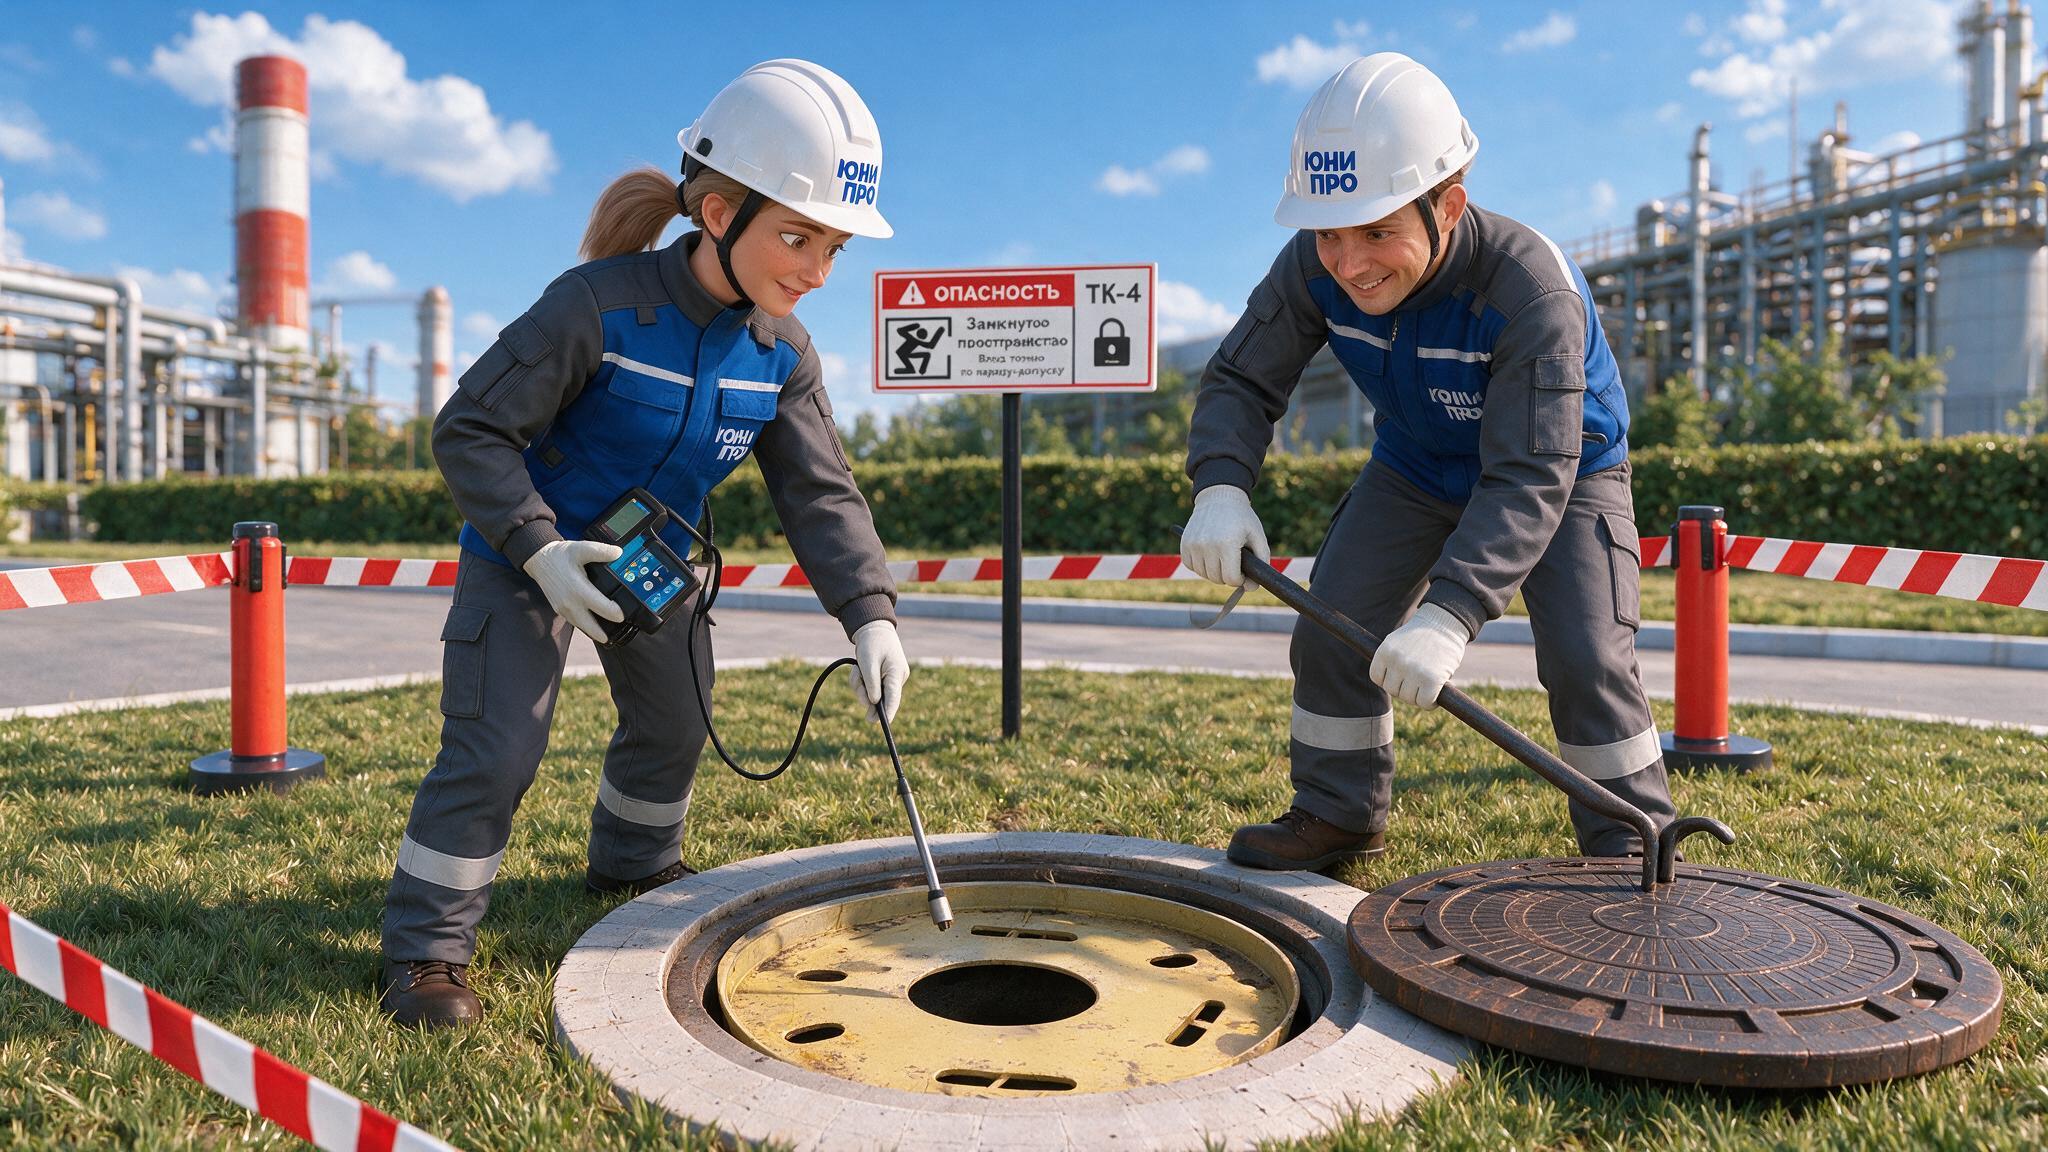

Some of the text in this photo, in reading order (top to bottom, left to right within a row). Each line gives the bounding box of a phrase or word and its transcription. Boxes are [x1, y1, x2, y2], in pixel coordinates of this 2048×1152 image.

[837, 158, 878, 184] ЮНИ
[1304, 151, 1356, 171] ЮНИ
[842, 181, 876, 205] ПРО
[1310, 173, 1358, 195] ПРО
[934, 284, 1061, 302] ОПАСНОСТЬ
[1085, 282, 1142, 304] ТК-4
